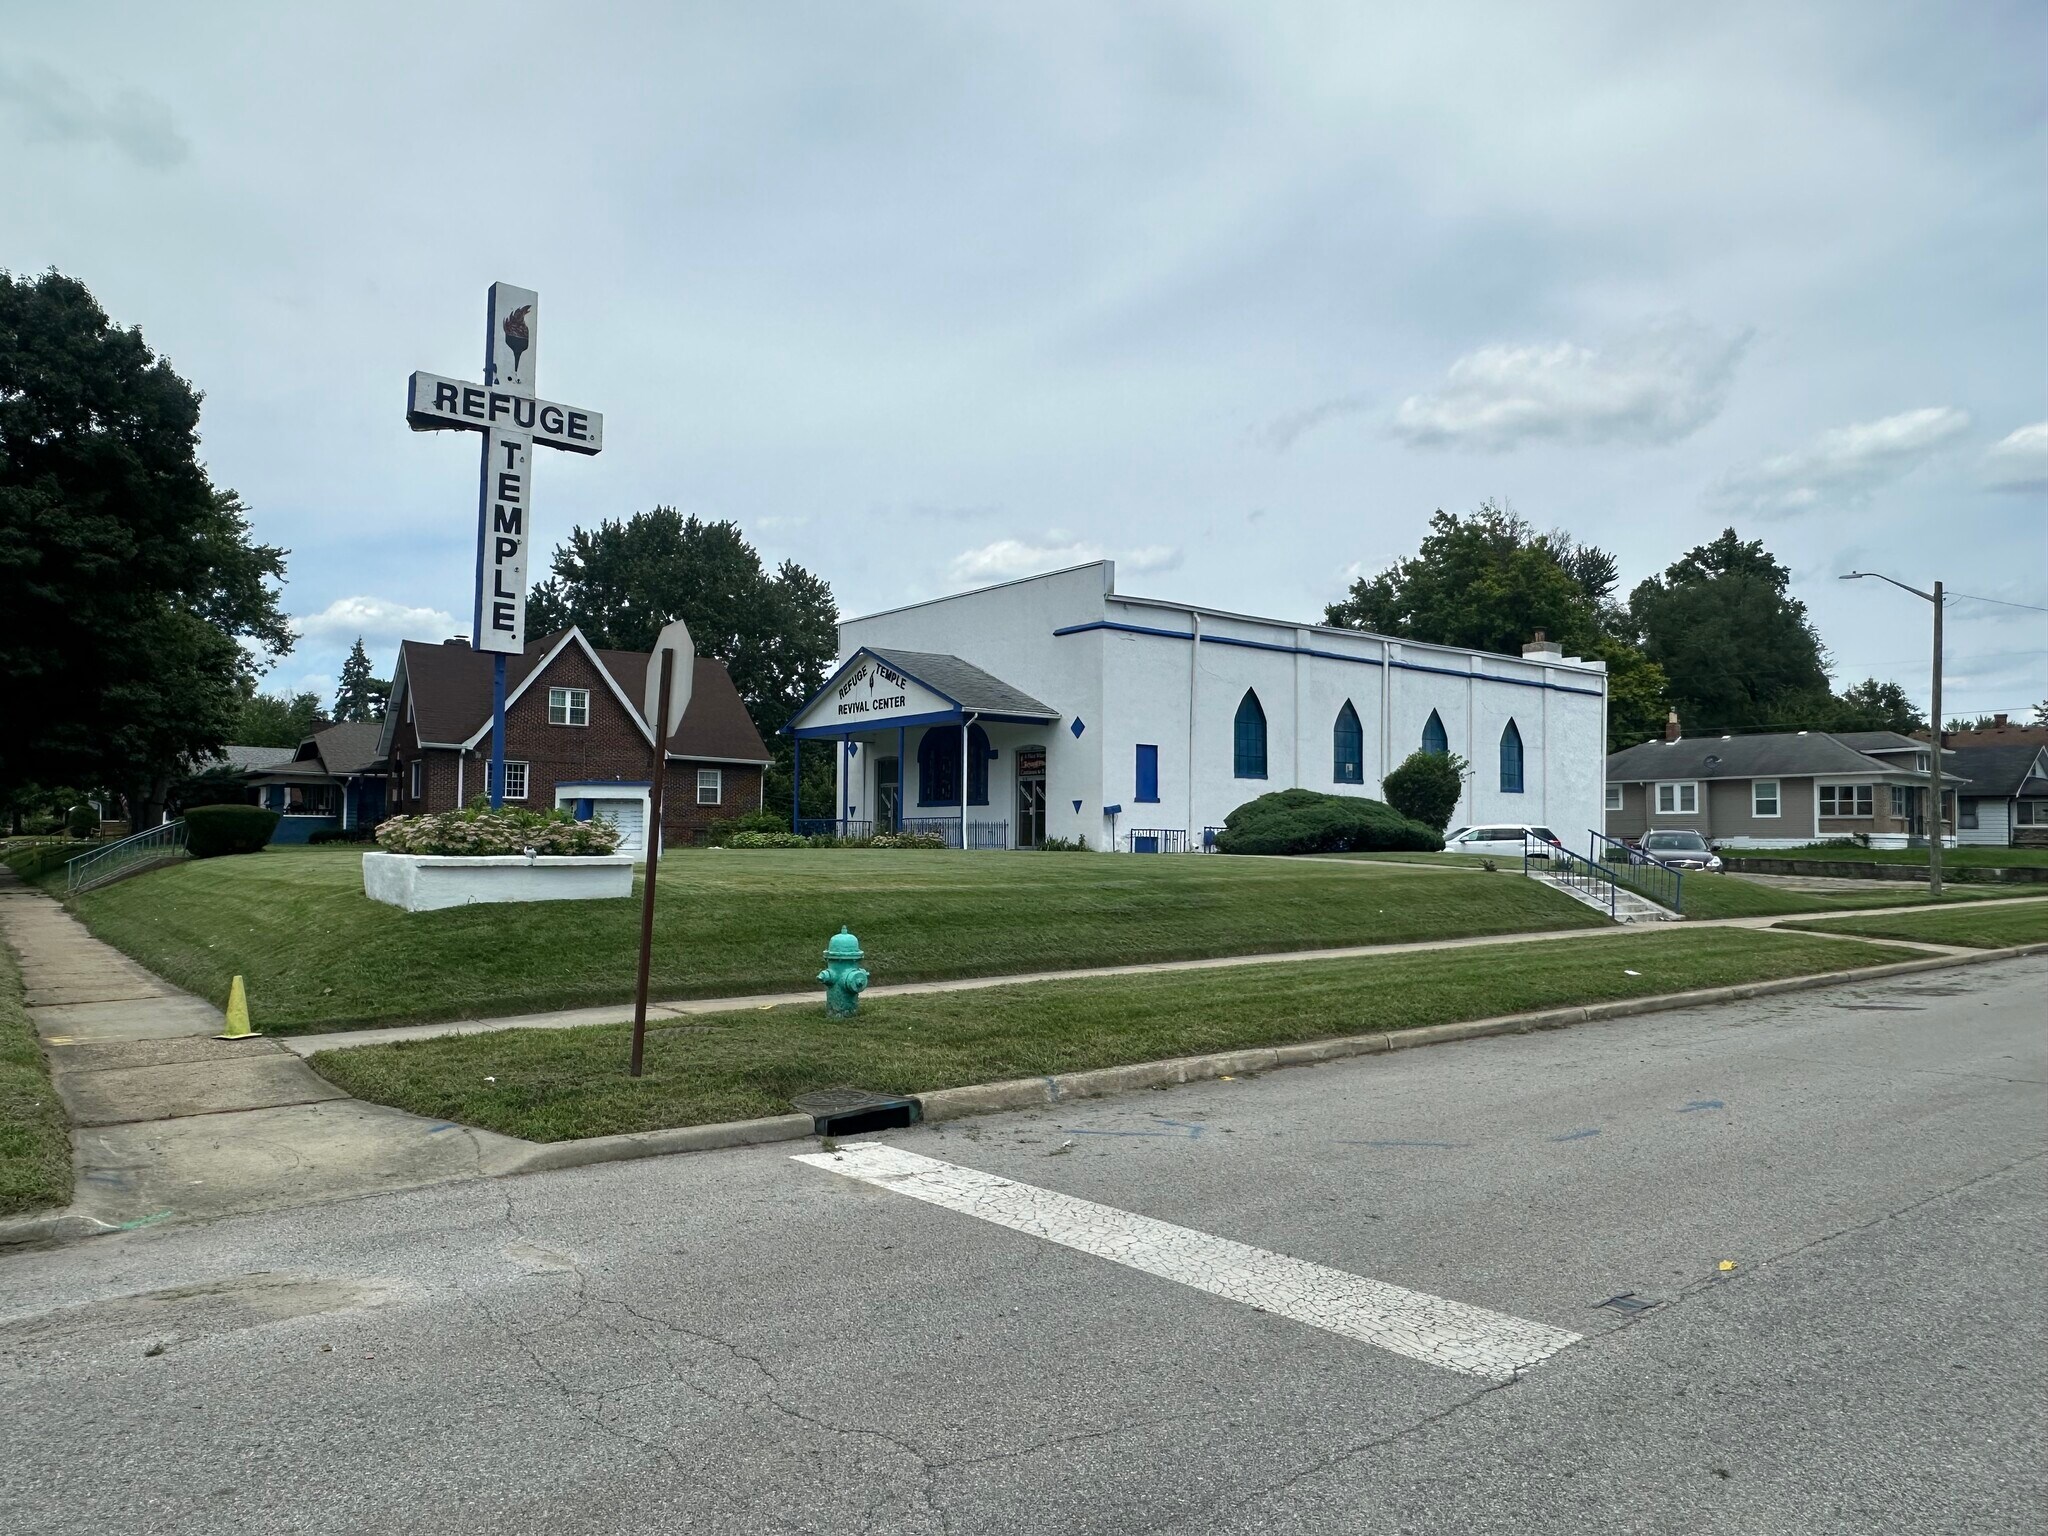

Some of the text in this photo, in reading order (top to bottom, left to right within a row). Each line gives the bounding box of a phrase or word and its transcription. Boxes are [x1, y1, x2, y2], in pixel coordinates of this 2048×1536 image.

[436, 382, 587, 440] REFUGE
[494, 441, 522, 631] TEMPLE
[839, 663, 906, 699] REFUGE TEMPLE
[838, 696, 905, 715] REVIVAL CENTER
